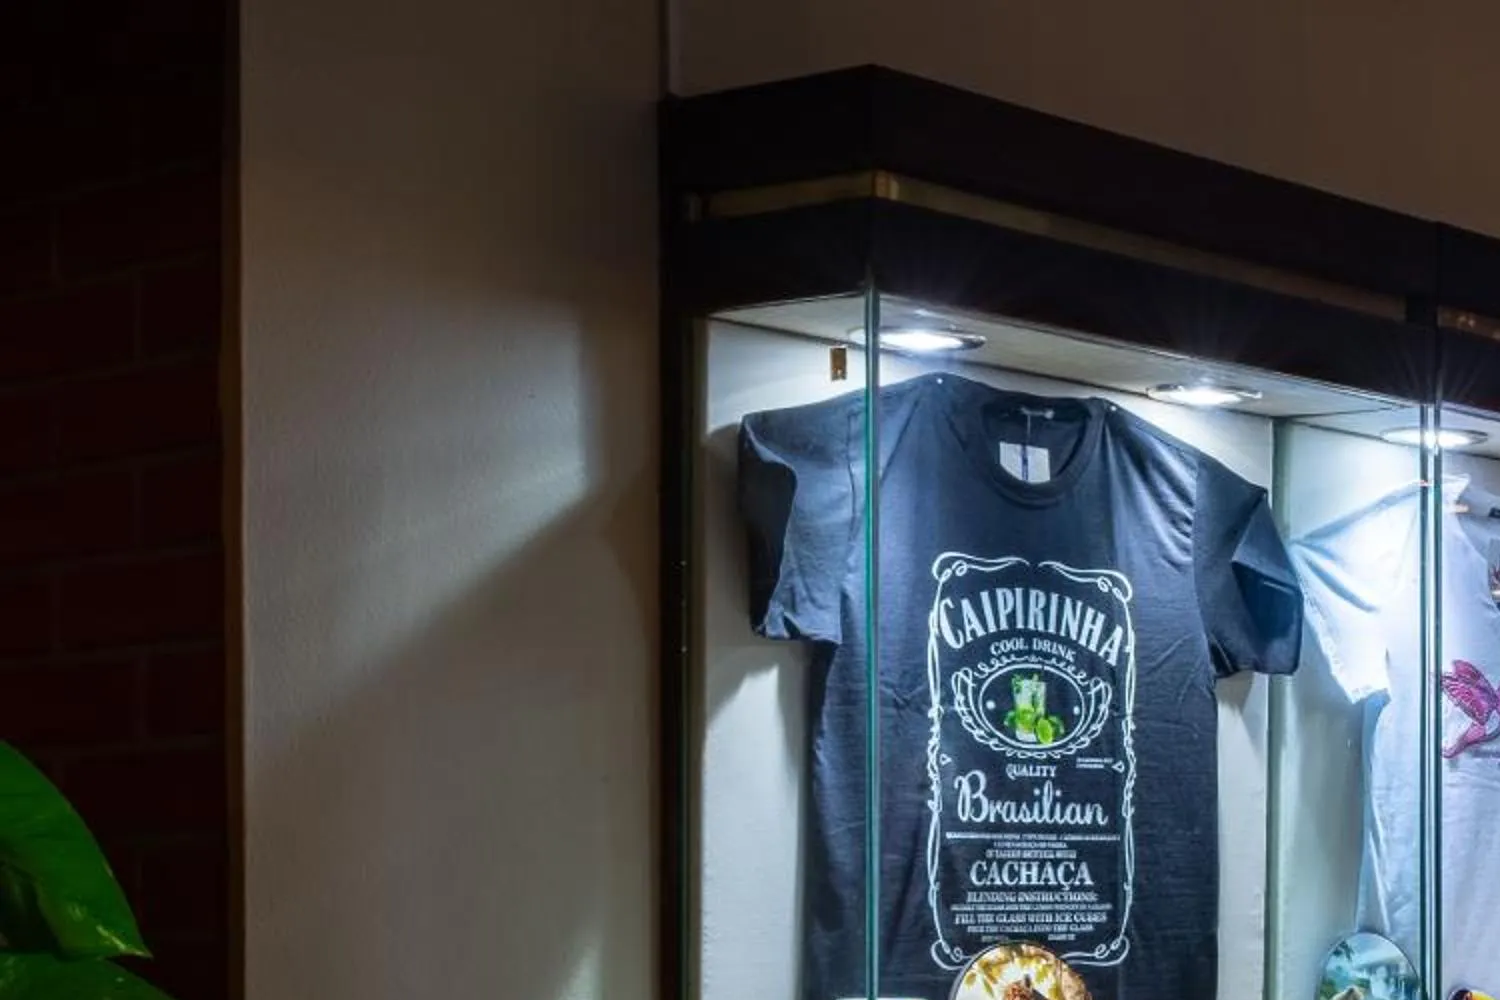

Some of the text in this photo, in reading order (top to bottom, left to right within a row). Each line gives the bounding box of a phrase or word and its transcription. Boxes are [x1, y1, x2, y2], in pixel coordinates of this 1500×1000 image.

[939, 586, 1124, 667] CAIPIRINHA
[990, 637, 1076, 662] COOL DRINK
[1005, 763, 1057, 780] QUALITY
[953, 769, 1109, 826] Brasilian
[969, 860, 1094, 891] CACHAÇA
